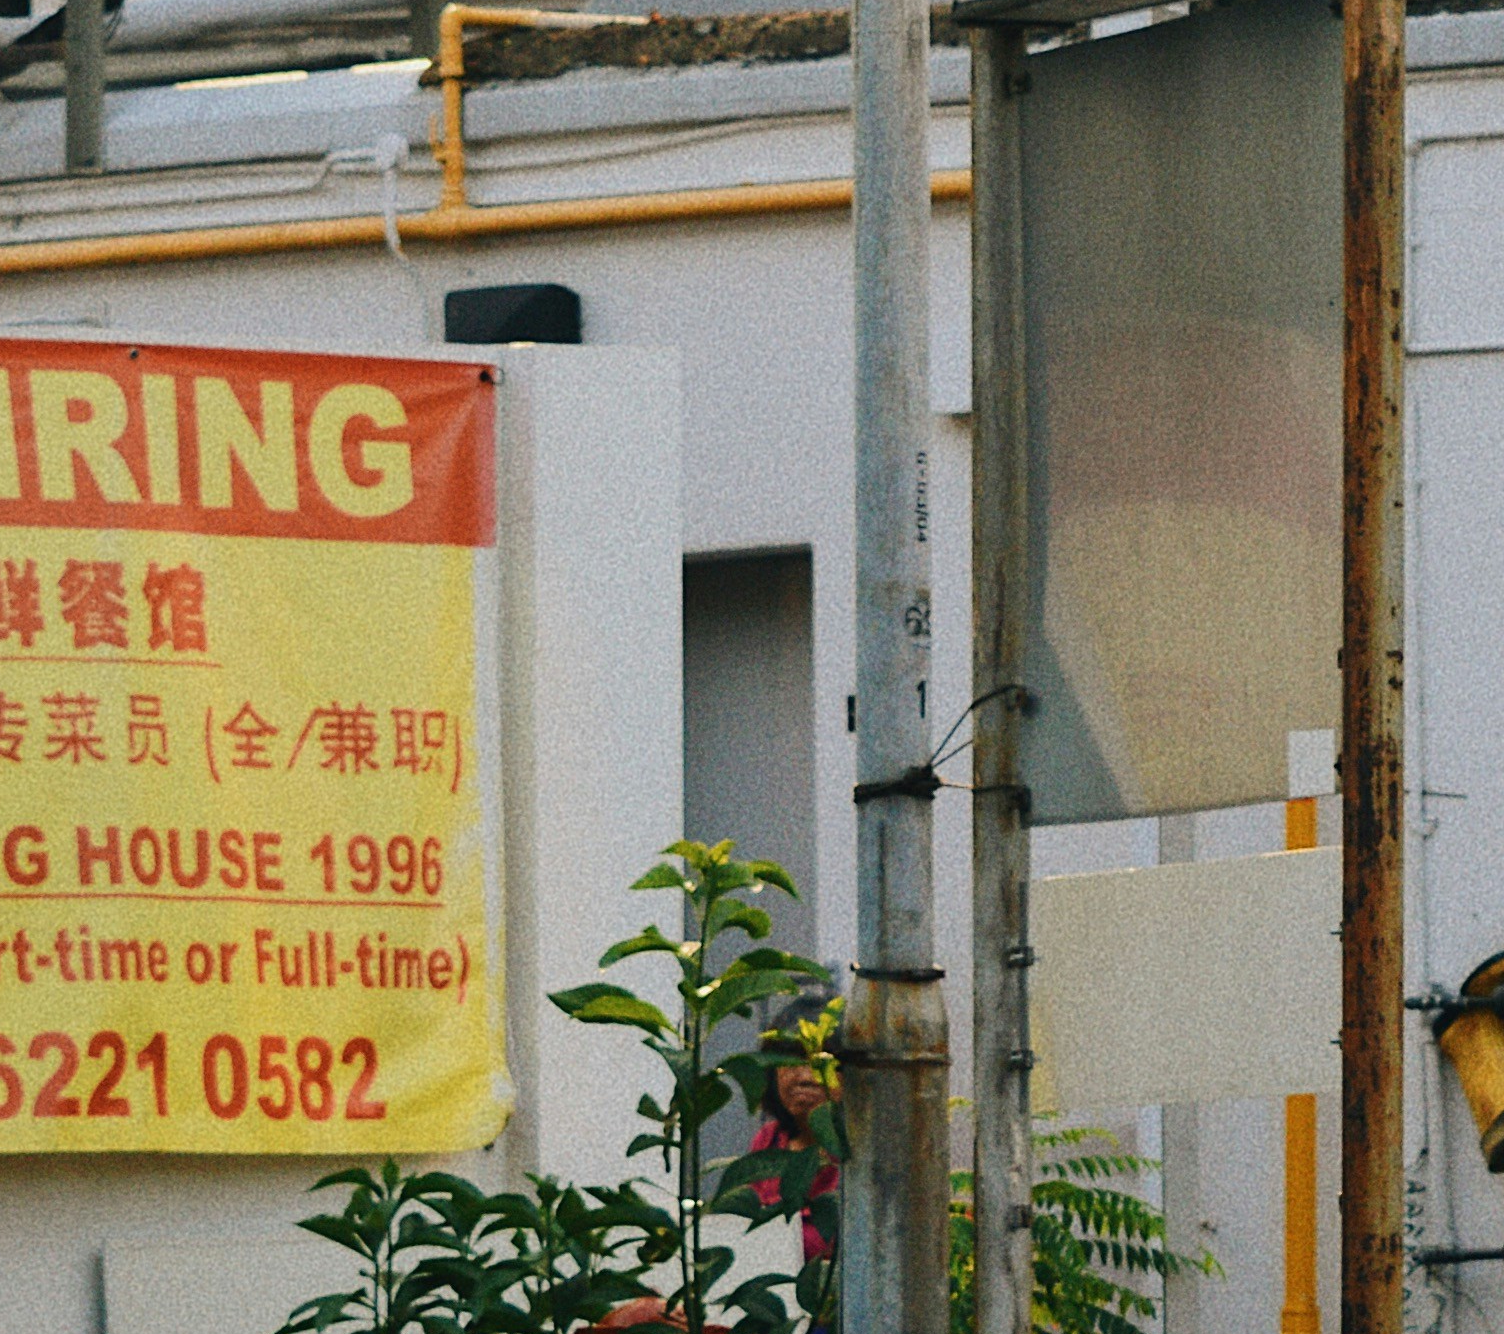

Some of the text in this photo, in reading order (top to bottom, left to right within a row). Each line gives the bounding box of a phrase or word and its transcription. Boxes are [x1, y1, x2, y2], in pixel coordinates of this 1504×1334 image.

[76, 825, 285, 892] HOUSE
[309, 833, 444, 896] 1996
[186, 941, 239, 985] or
[255, 928, 470, 1005] Full-time)
[201, 1034, 388, 1122] 0582
